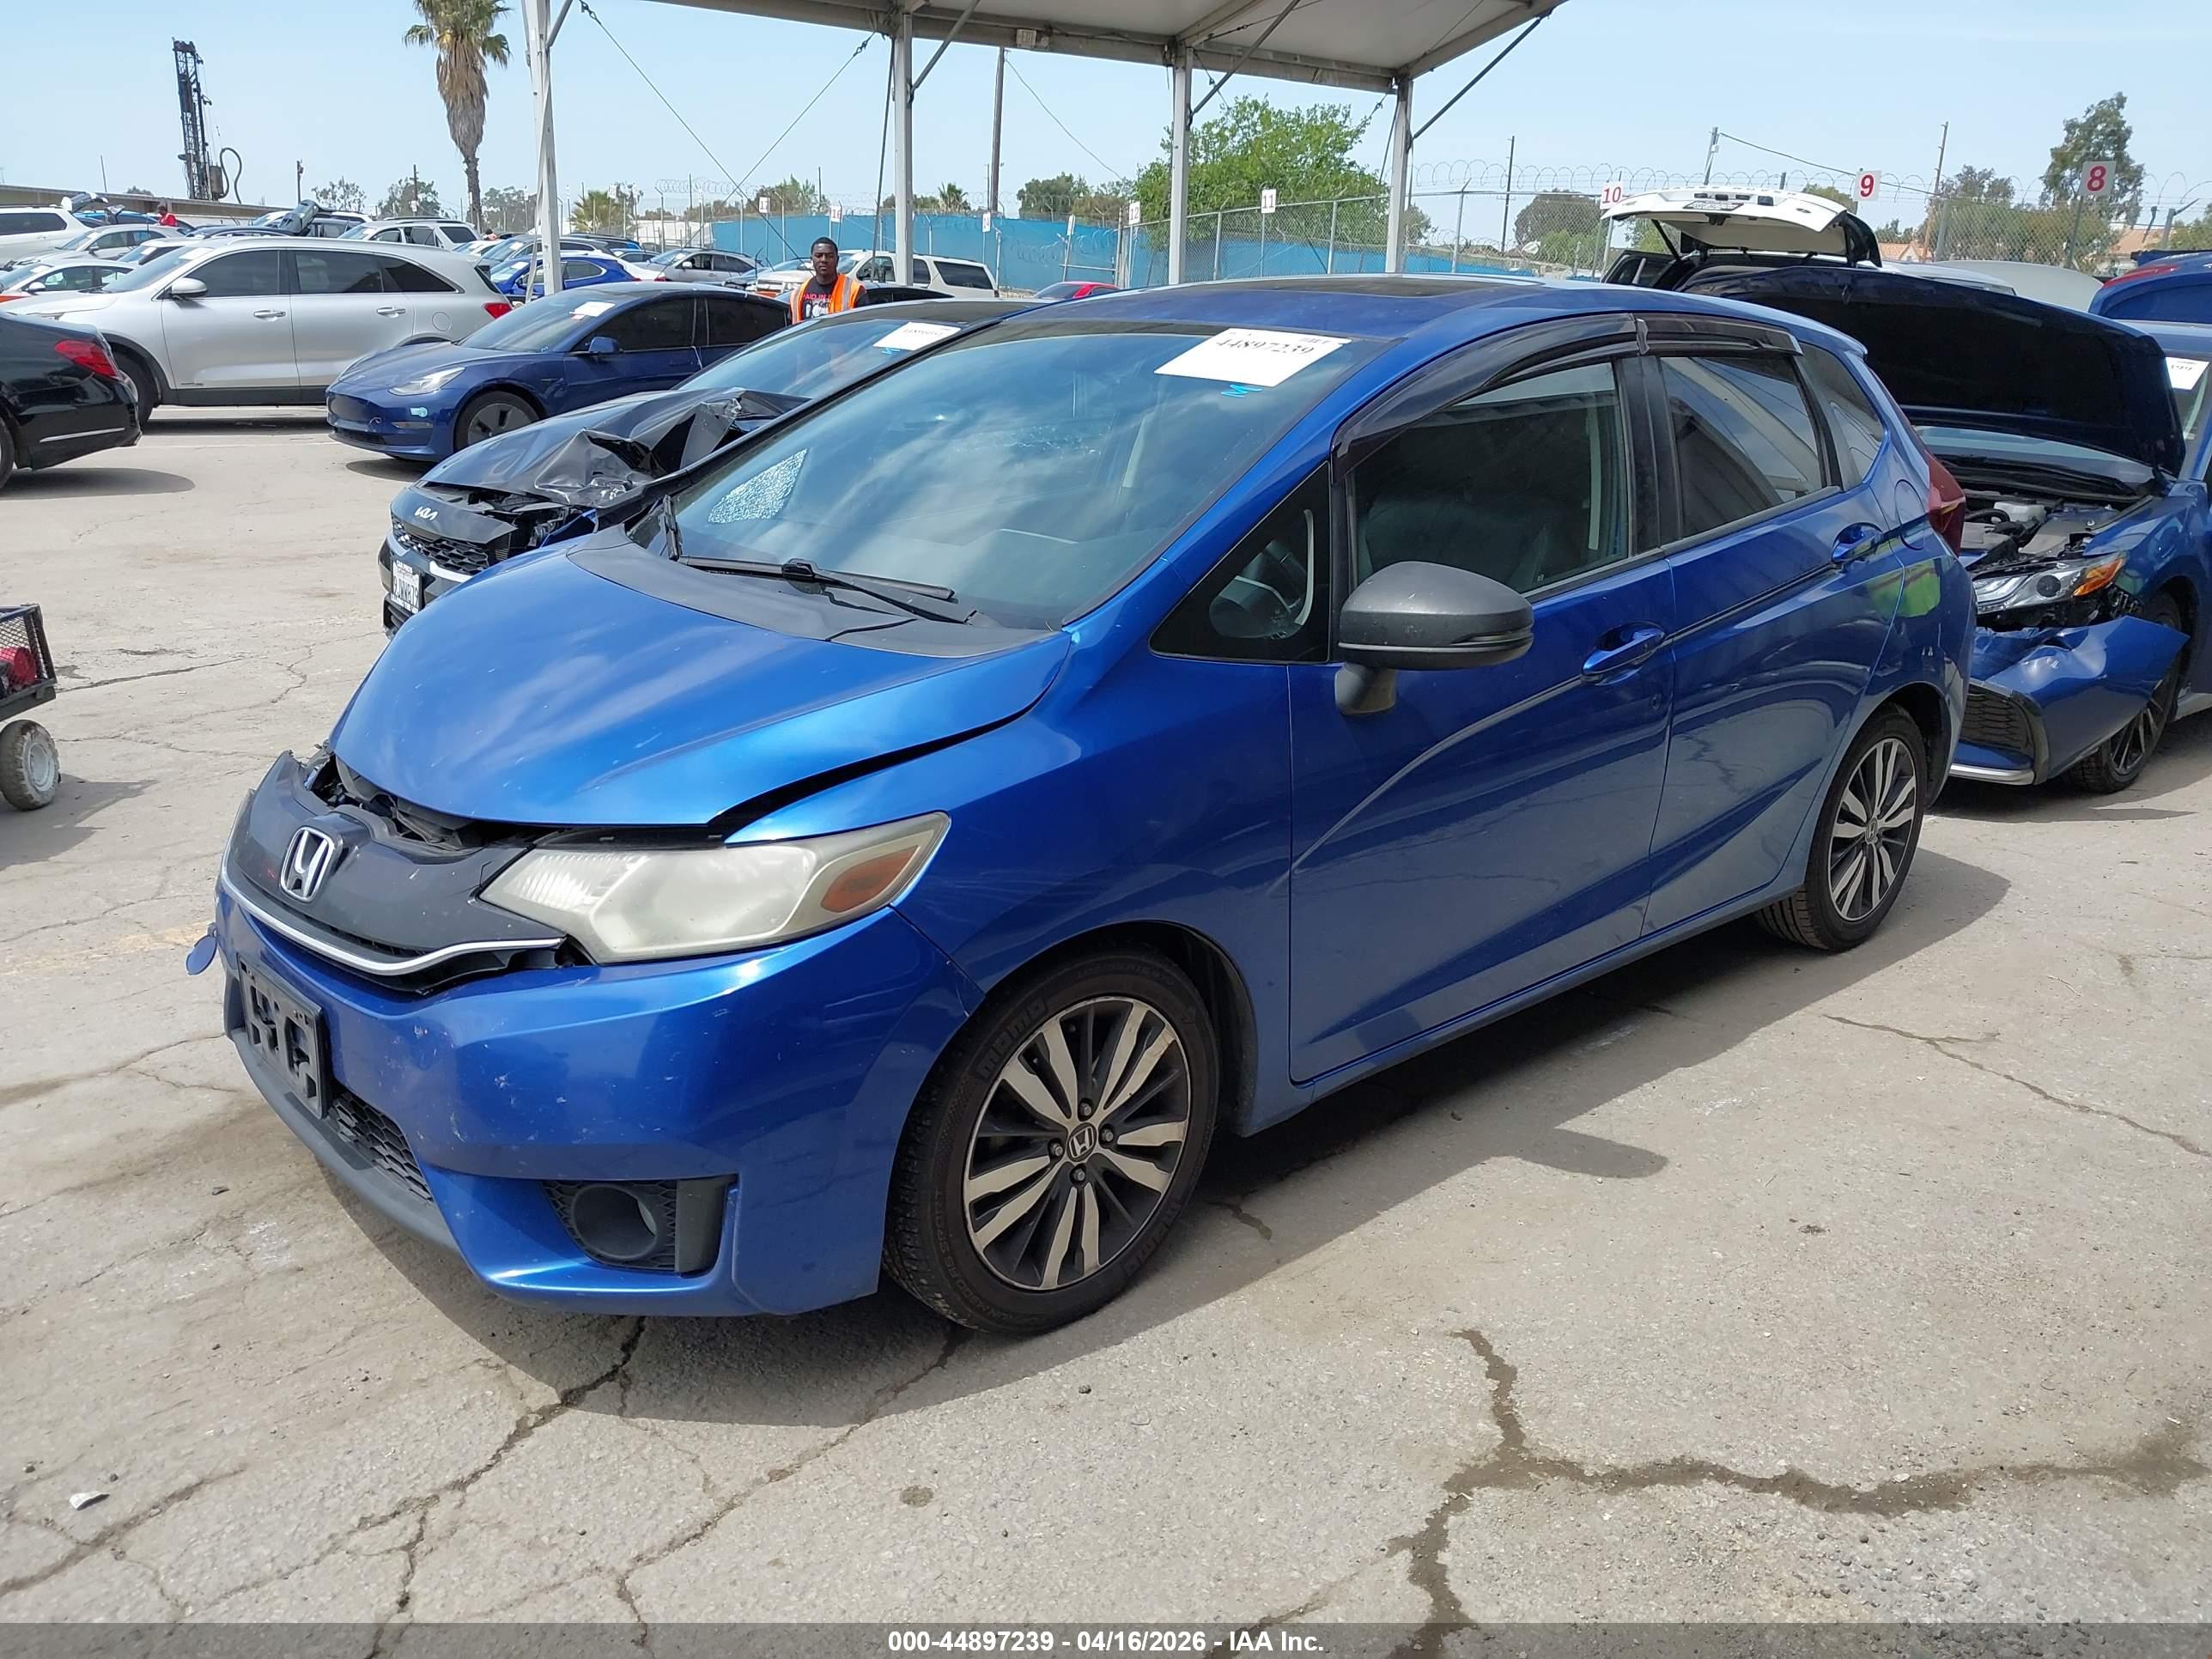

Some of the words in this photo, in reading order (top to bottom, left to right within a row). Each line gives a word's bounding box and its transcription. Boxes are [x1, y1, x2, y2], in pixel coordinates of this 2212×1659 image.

[1861, 174, 1875, 197] 9
[2087, 166, 2106, 191] 8
[1262, 195, 1273, 209] 11
[1602, 186, 1621, 204] 10
[1130, 207, 1139, 220] 12
